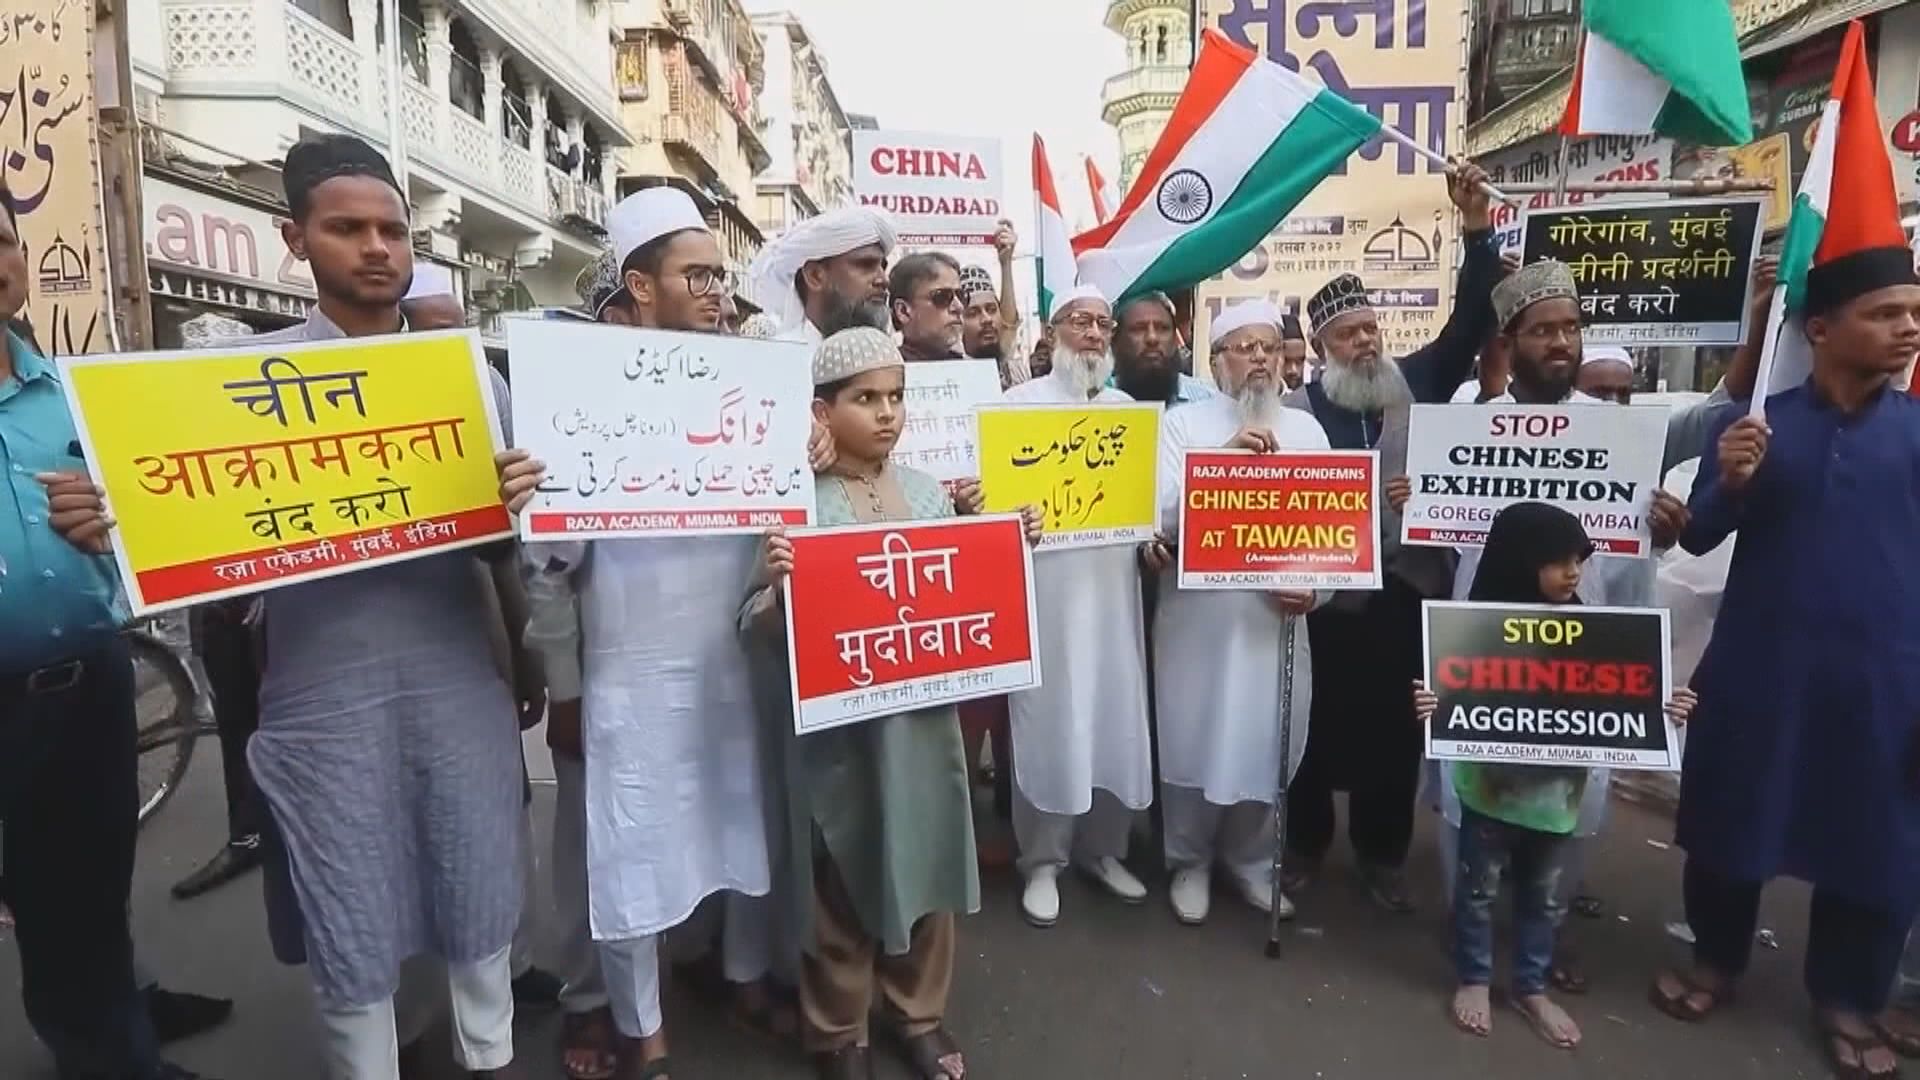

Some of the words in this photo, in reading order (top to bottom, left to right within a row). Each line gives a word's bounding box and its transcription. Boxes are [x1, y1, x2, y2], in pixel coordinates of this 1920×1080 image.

[870, 147, 987, 179] CHINA
[860, 194, 1000, 215] MURDABAD
[1550, 214, 1656, 246] गोरेगांव,
[1669, 208, 1733, 248] मुंबई
[1641, 248, 1736, 281] प्रदर्शनी
[1580, 288, 1621, 316] बंद
[1627, 286, 1680, 315] करो
[223, 357, 368, 428] चीन
[1490, 414, 1571, 438] STOP
[1011, 416, 1089, 467] حکومت
[1085, 423, 1128, 469] چینی
[133, 417, 466, 500] आक्रामकता
[1193, 465, 1227, 479] RAZA
[1228, 465, 1291, 480] ACADEMY
[1293, 467, 1365, 481] CONDEMNS
[1449, 446, 1609, 471] CHINESE
[742, 462, 774, 497] چینی
[1420, 474, 1637, 503] EXHIBITION
[245, 497, 319, 541] बंद
[330, 477, 412, 528] करो
[1188, 489, 1280, 510] CHINESE
[1286, 491, 1368, 512] ATTACK
[1428, 505, 1501, 523] GOREGA
[404, 518, 458, 546] इंडिया
[566, 513, 607, 530] RAZA
[608, 511, 683, 530] ACADEMY,
[686, 510, 738, 528] MUMBAI
[749, 510, 785, 527] INDIA
[1112, 527, 1136, 539] INDIA
[1200, 530, 1225, 548] AT
[1231, 523, 1357, 550] TAWANG
[1431, 529, 1458, 542] RAZA
[1592, 540, 1611, 551] DIA
[856, 531, 959, 601] चीन
[1204, 574, 1228, 584] RAZA
[1326, 575, 1353, 584] INDIA
[835, 606, 995, 685] मुर्दाबाद
[1503, 617, 1584, 645] STOP
[1438, 658, 1652, 696] CHINESE
[1447, 704, 1648, 738] AGGRESSION
[1456, 743, 1485, 755] RAZA
[1548, 749, 1593, 761] MUMBAI
[1604, 751, 1638, 763] INDIA
